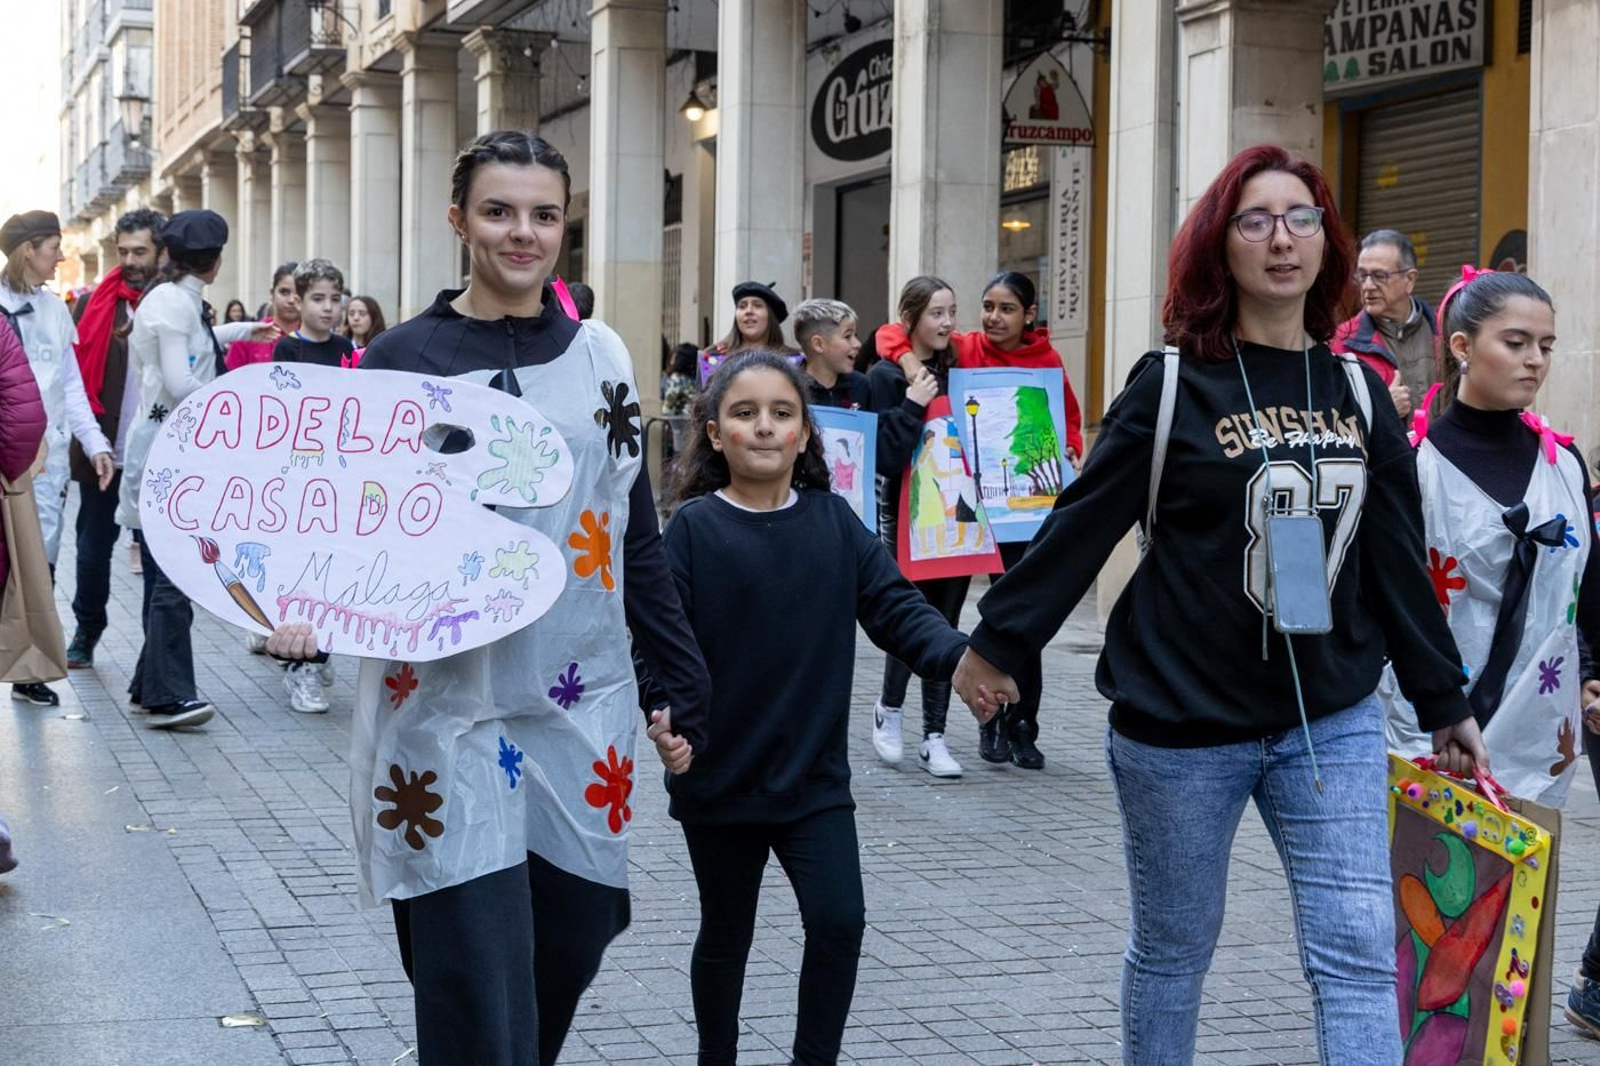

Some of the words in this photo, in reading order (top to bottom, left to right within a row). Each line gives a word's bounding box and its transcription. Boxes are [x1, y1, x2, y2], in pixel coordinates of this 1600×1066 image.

[1368, 35, 1472, 76] SALON
[1069, 161, 1081, 319] RESTAURANTE
[194, 390, 425, 454] ADELA
[1215, 405, 1369, 458] SUNSHIN
[1248, 428, 1279, 448] Be
[1283, 428, 1357, 449] Happy
[168, 475, 443, 536] CASADO
[277, 550, 469, 621] Málaga
